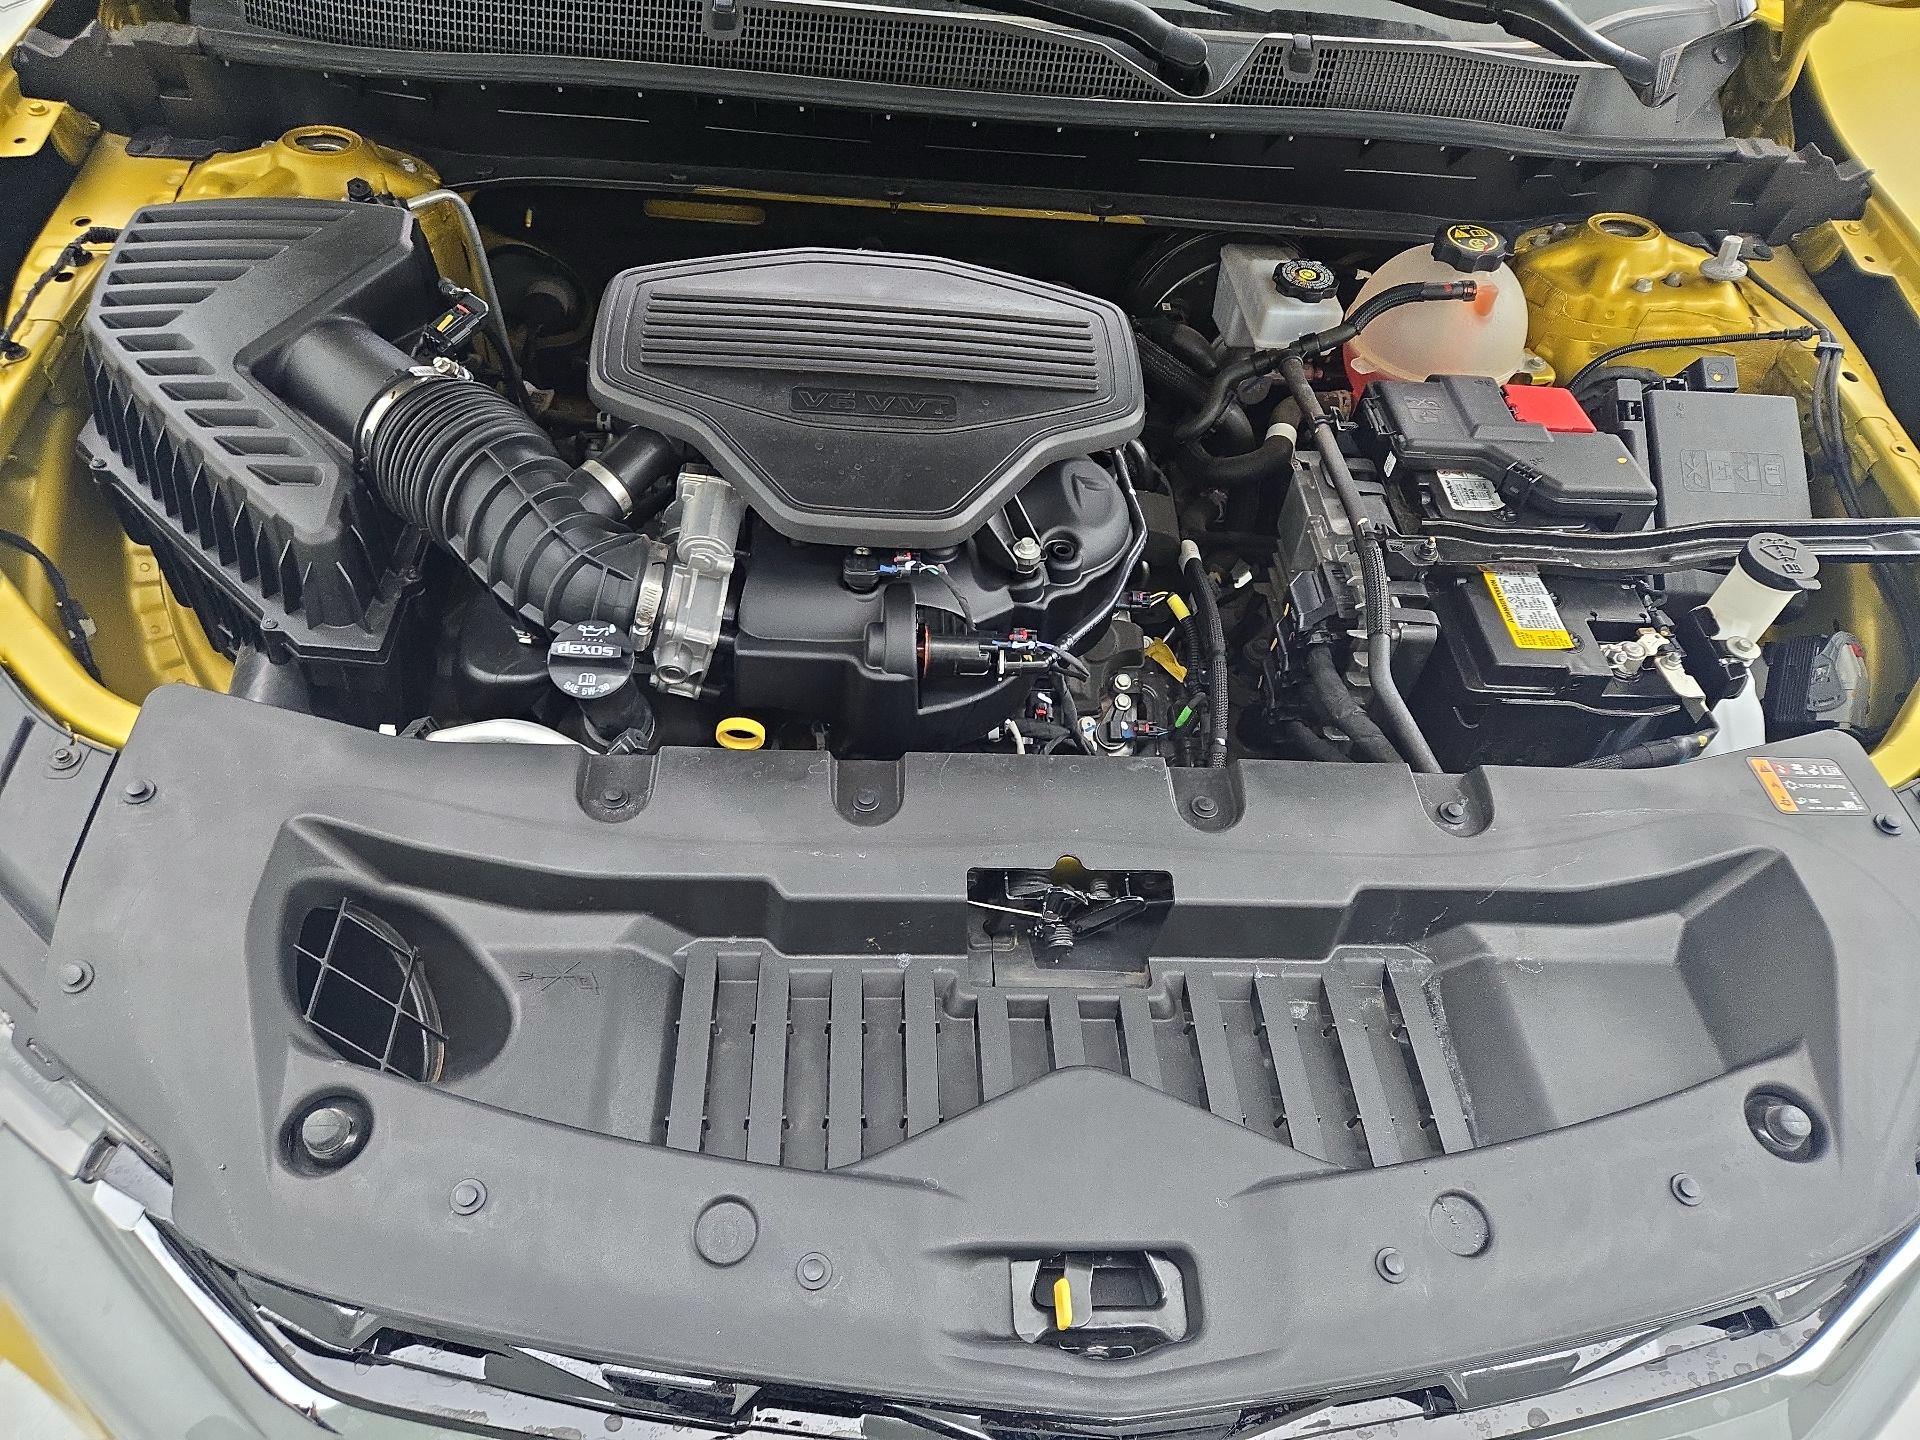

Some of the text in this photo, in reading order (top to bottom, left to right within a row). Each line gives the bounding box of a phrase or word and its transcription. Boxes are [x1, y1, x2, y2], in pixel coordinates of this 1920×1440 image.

[799, 391, 856, 409] V6
[557, 641, 615, 656] dexos
[563, 681, 611, 696] SAE 5W-30
